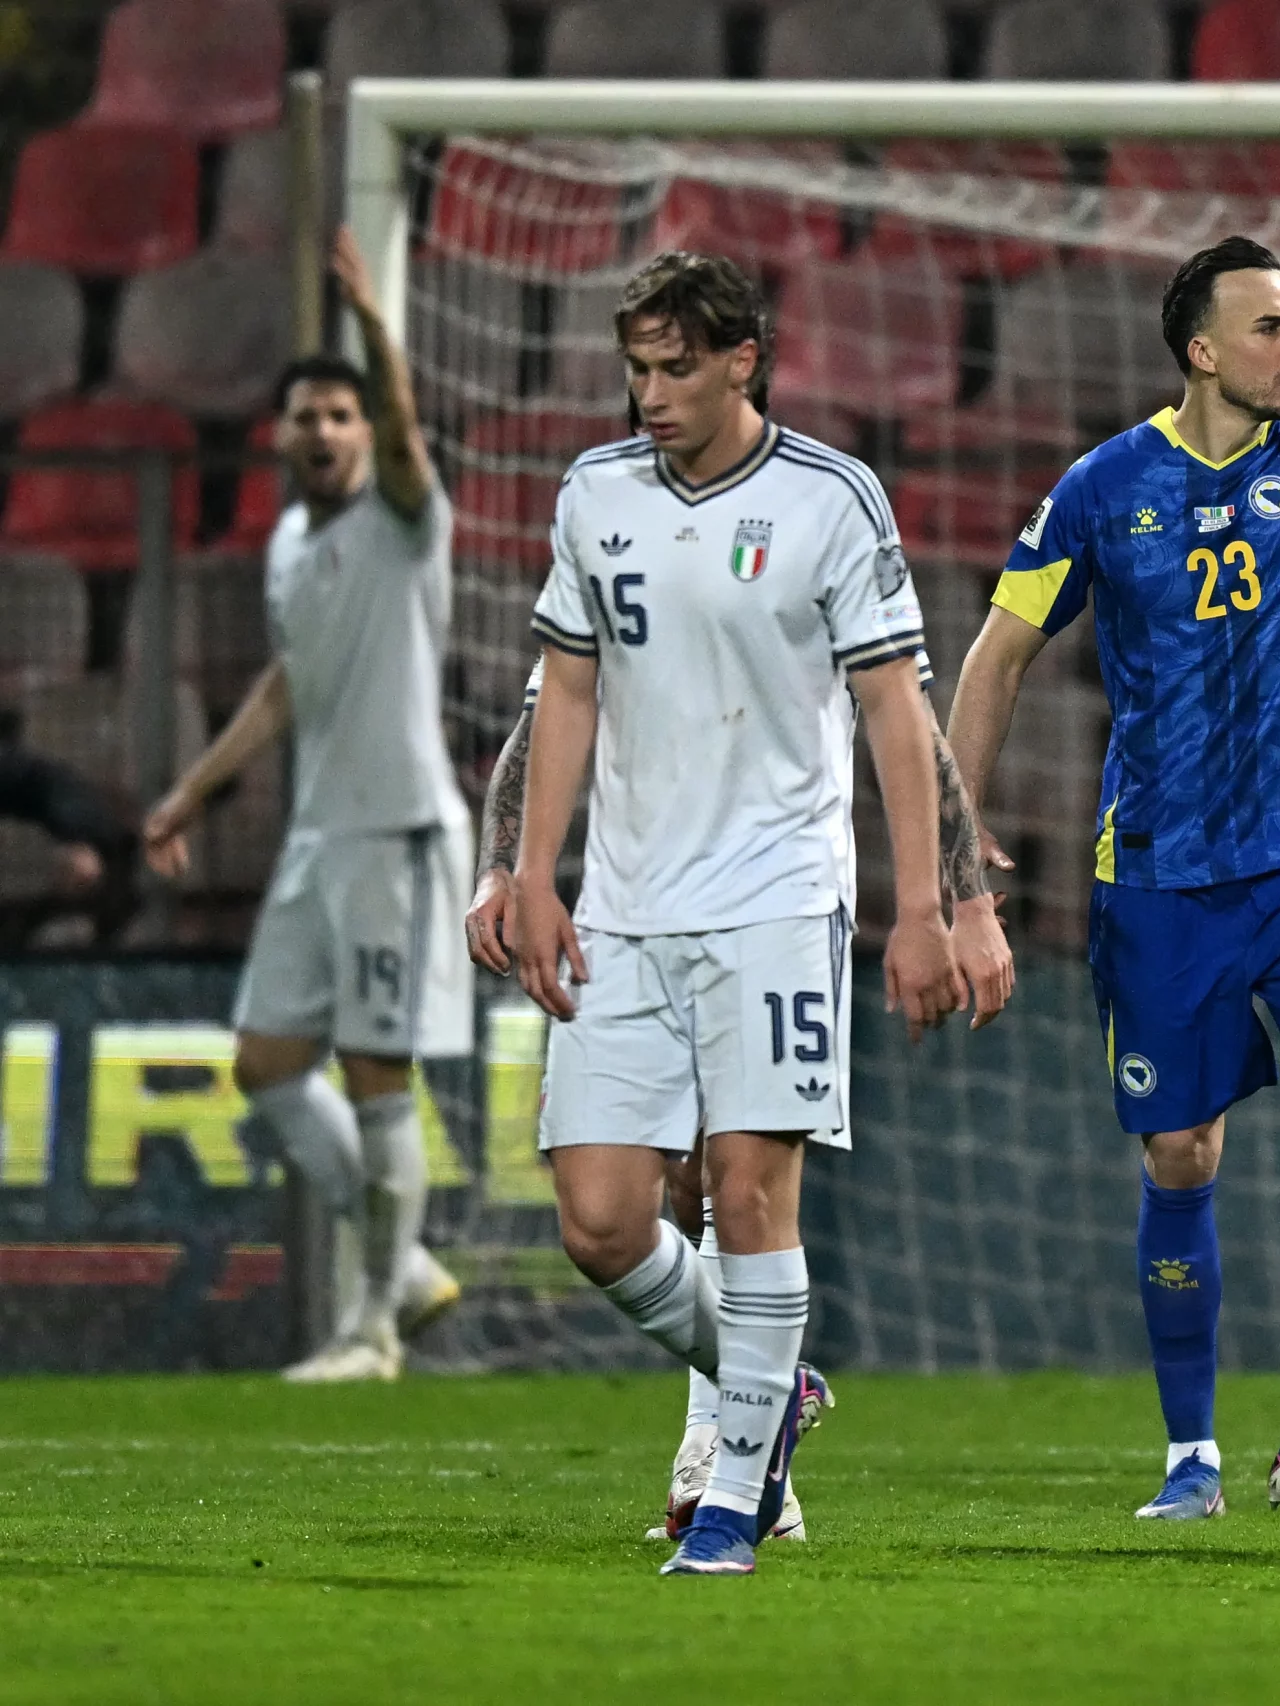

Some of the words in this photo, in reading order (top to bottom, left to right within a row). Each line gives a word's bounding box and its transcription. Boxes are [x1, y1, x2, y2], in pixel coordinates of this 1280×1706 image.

[1130, 524, 1164, 534] KELME
[589, 572, 648, 646] 15
[1186, 540, 1262, 621] 23
[355, 945, 403, 1005] 19
[764, 991, 829, 1066] 15
[720, 1390, 774, 1407] ITALIA
